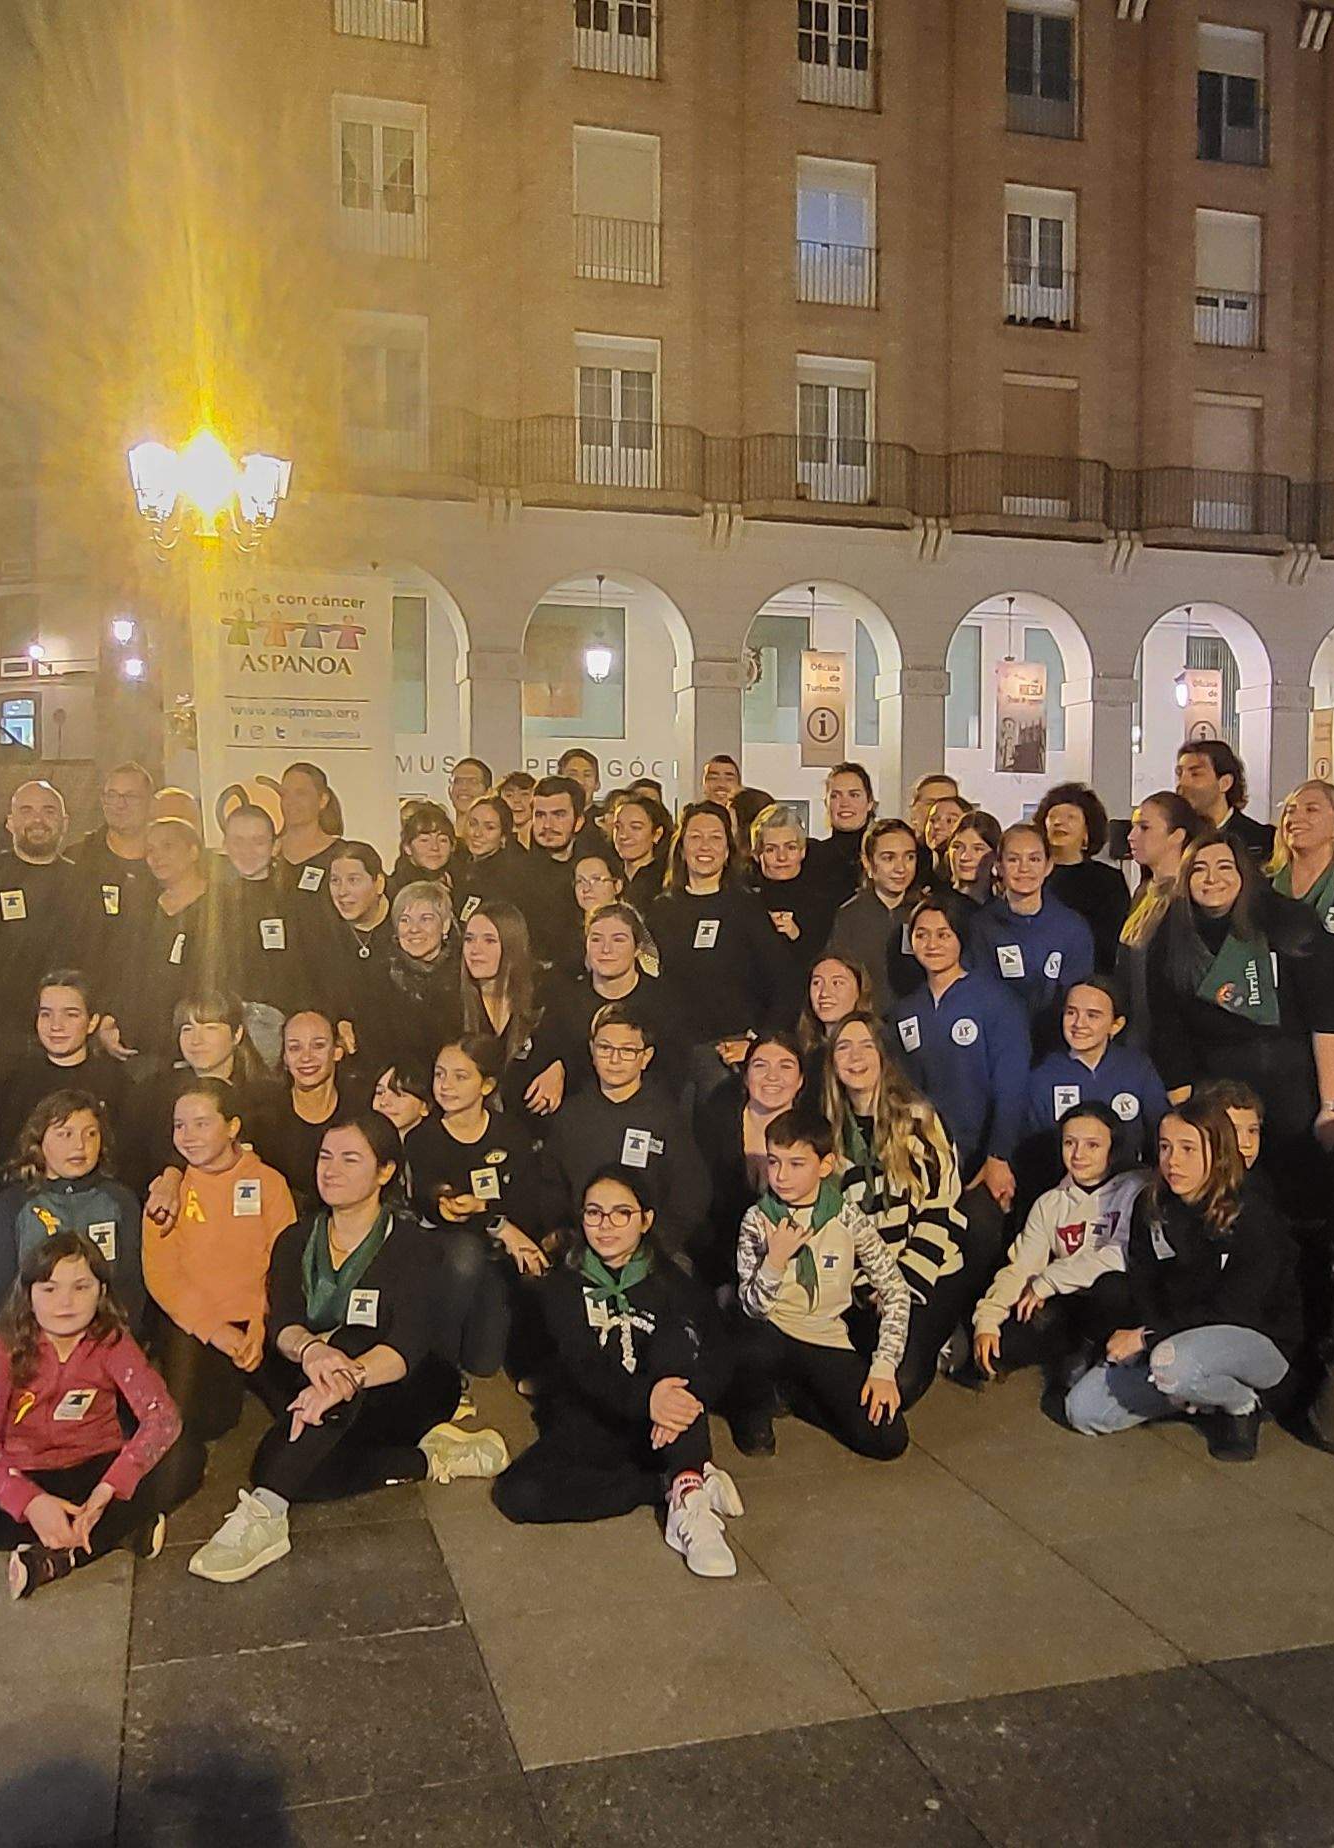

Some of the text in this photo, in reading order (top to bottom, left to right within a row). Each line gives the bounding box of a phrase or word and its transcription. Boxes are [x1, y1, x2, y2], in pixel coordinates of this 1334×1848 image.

[277, 594, 307, 605] con
[312, 594, 366, 610] cáncer
[240, 653, 352, 676] ASPANOA
[395, 755, 456, 774] MUS
